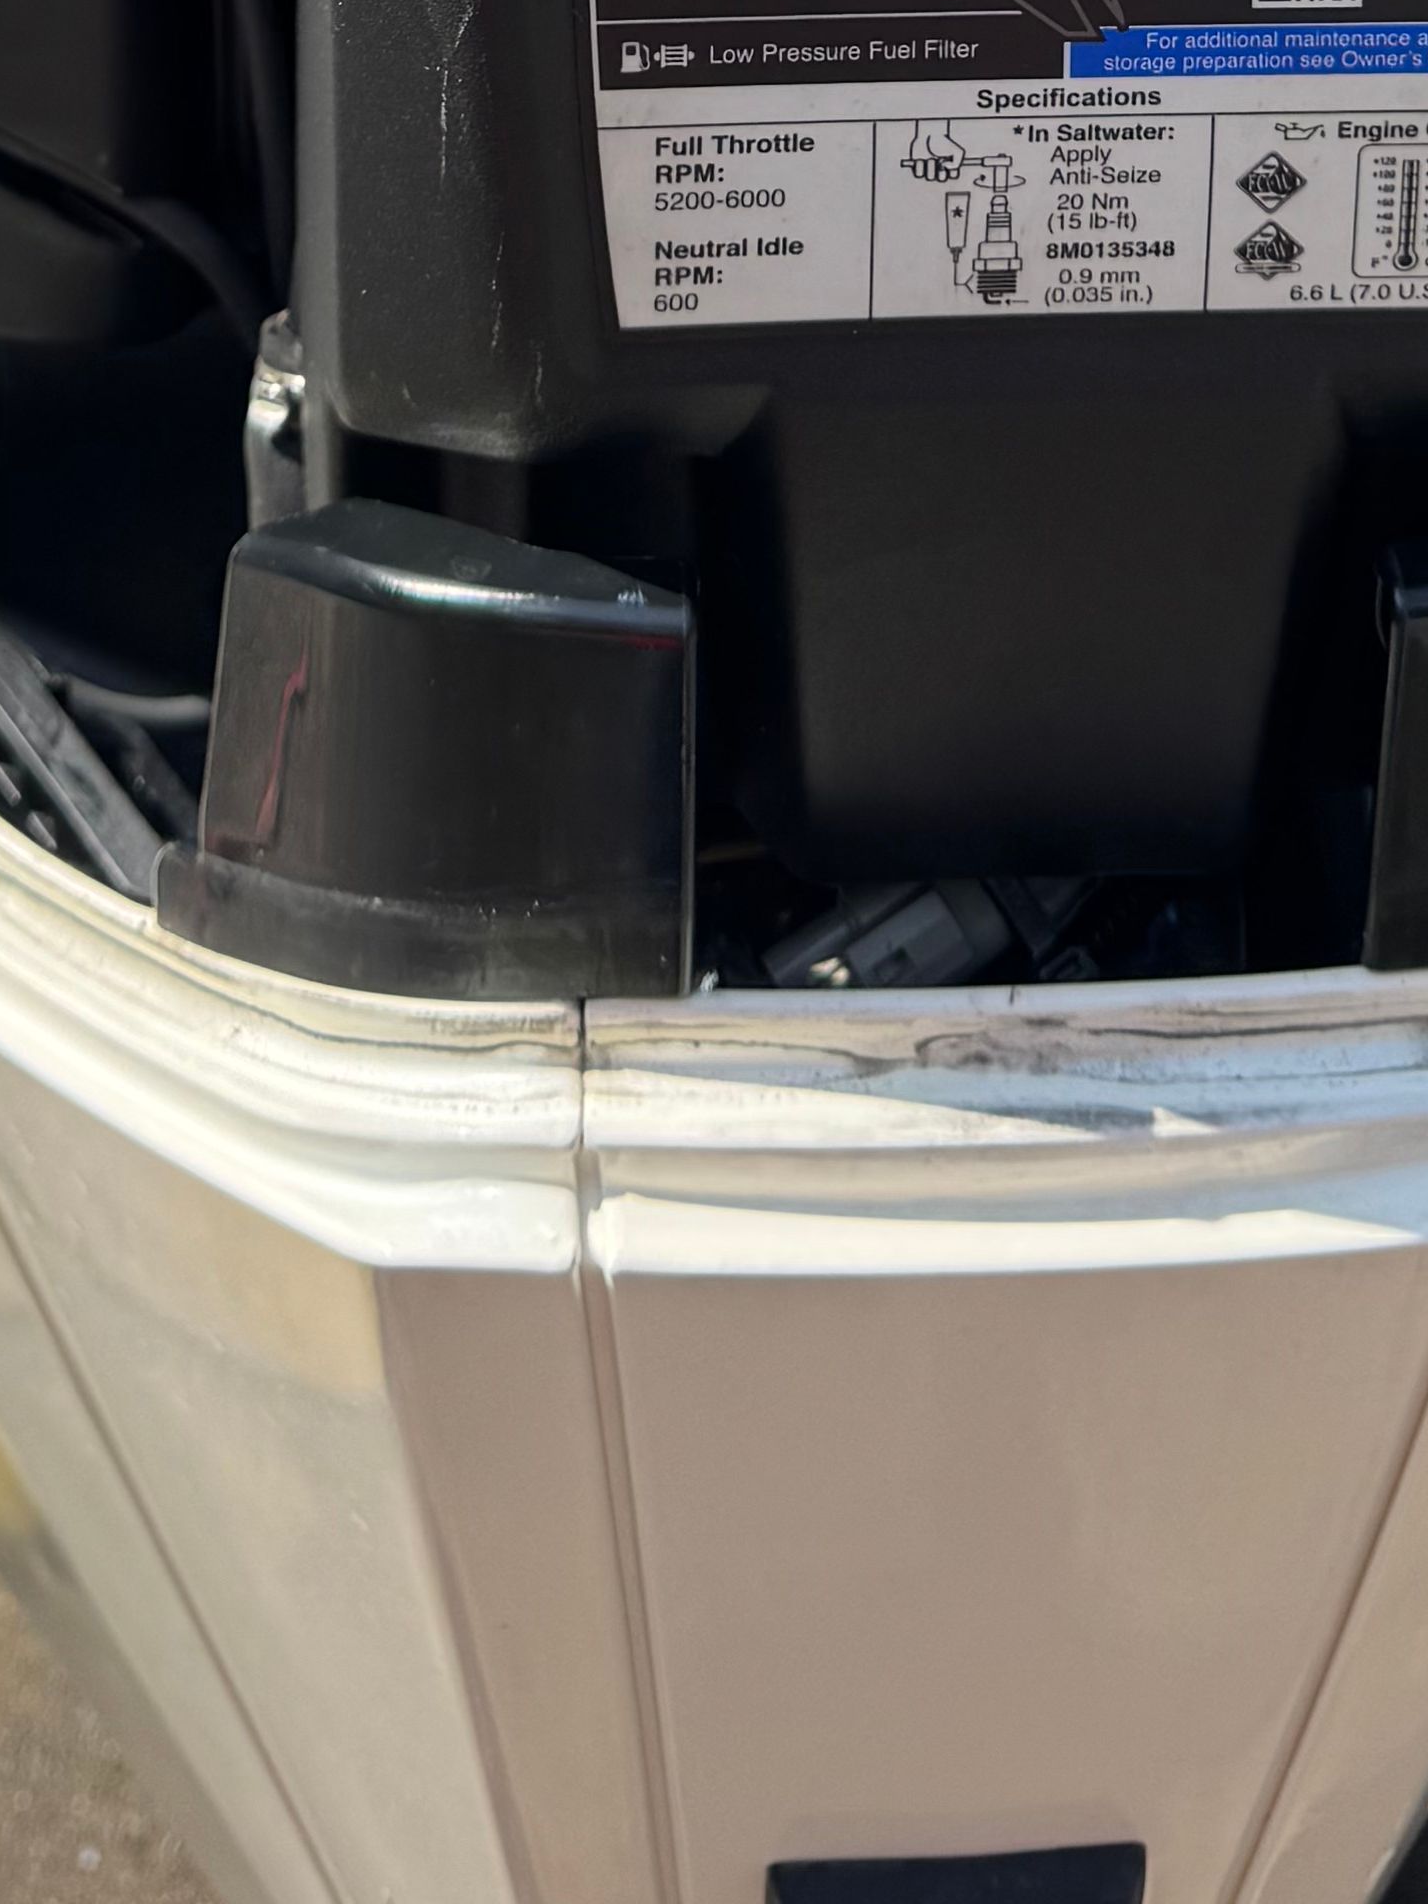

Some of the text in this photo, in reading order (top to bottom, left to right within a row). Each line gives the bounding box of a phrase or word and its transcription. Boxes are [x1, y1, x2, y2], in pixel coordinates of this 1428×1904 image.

[1146, 32, 1179, 49] For
[1185, 31, 1279, 49] additional
[1285, 30, 1410, 47] maintenance
[710, 40, 979, 64] Low Pressure Fuel Filter
[1104, 53, 1176, 74] storage
[1183, 53, 1293, 72] preparation
[1300, 53, 1334, 68] see
[1341, 51, 1422, 68] Owner's
[977, 88, 1161, 109] Specifications
[1057, 125, 1174, 141] Saltwater:
[1338, 121, 1419, 141] Engine
[656, 134, 815, 156] Full Throttle
[1050, 146, 1112, 166] Apply
[656, 164, 724, 183] RPM:
[1050, 166, 1161, 185] Anti-Seize
[655, 189, 785, 211] 5200-6000
[1057, 193, 1128, 210] 20 Nm
[1047, 211, 1137, 233] (15 lb-ft)
[655, 237, 804, 260] Neutral Idle
[1046, 241, 1175, 259] 8M0135348
[655, 267, 723, 286] RPM:
[1059, 269, 1140, 284] 0.9 mm
[654, 293, 698, 312] 600
[1044, 285, 1153, 306] (0.035 in.)
[1290, 285, 1323, 301] 6.6
[1331, 284, 1342, 300] L
[1351, 283, 1390, 303] (7.0
